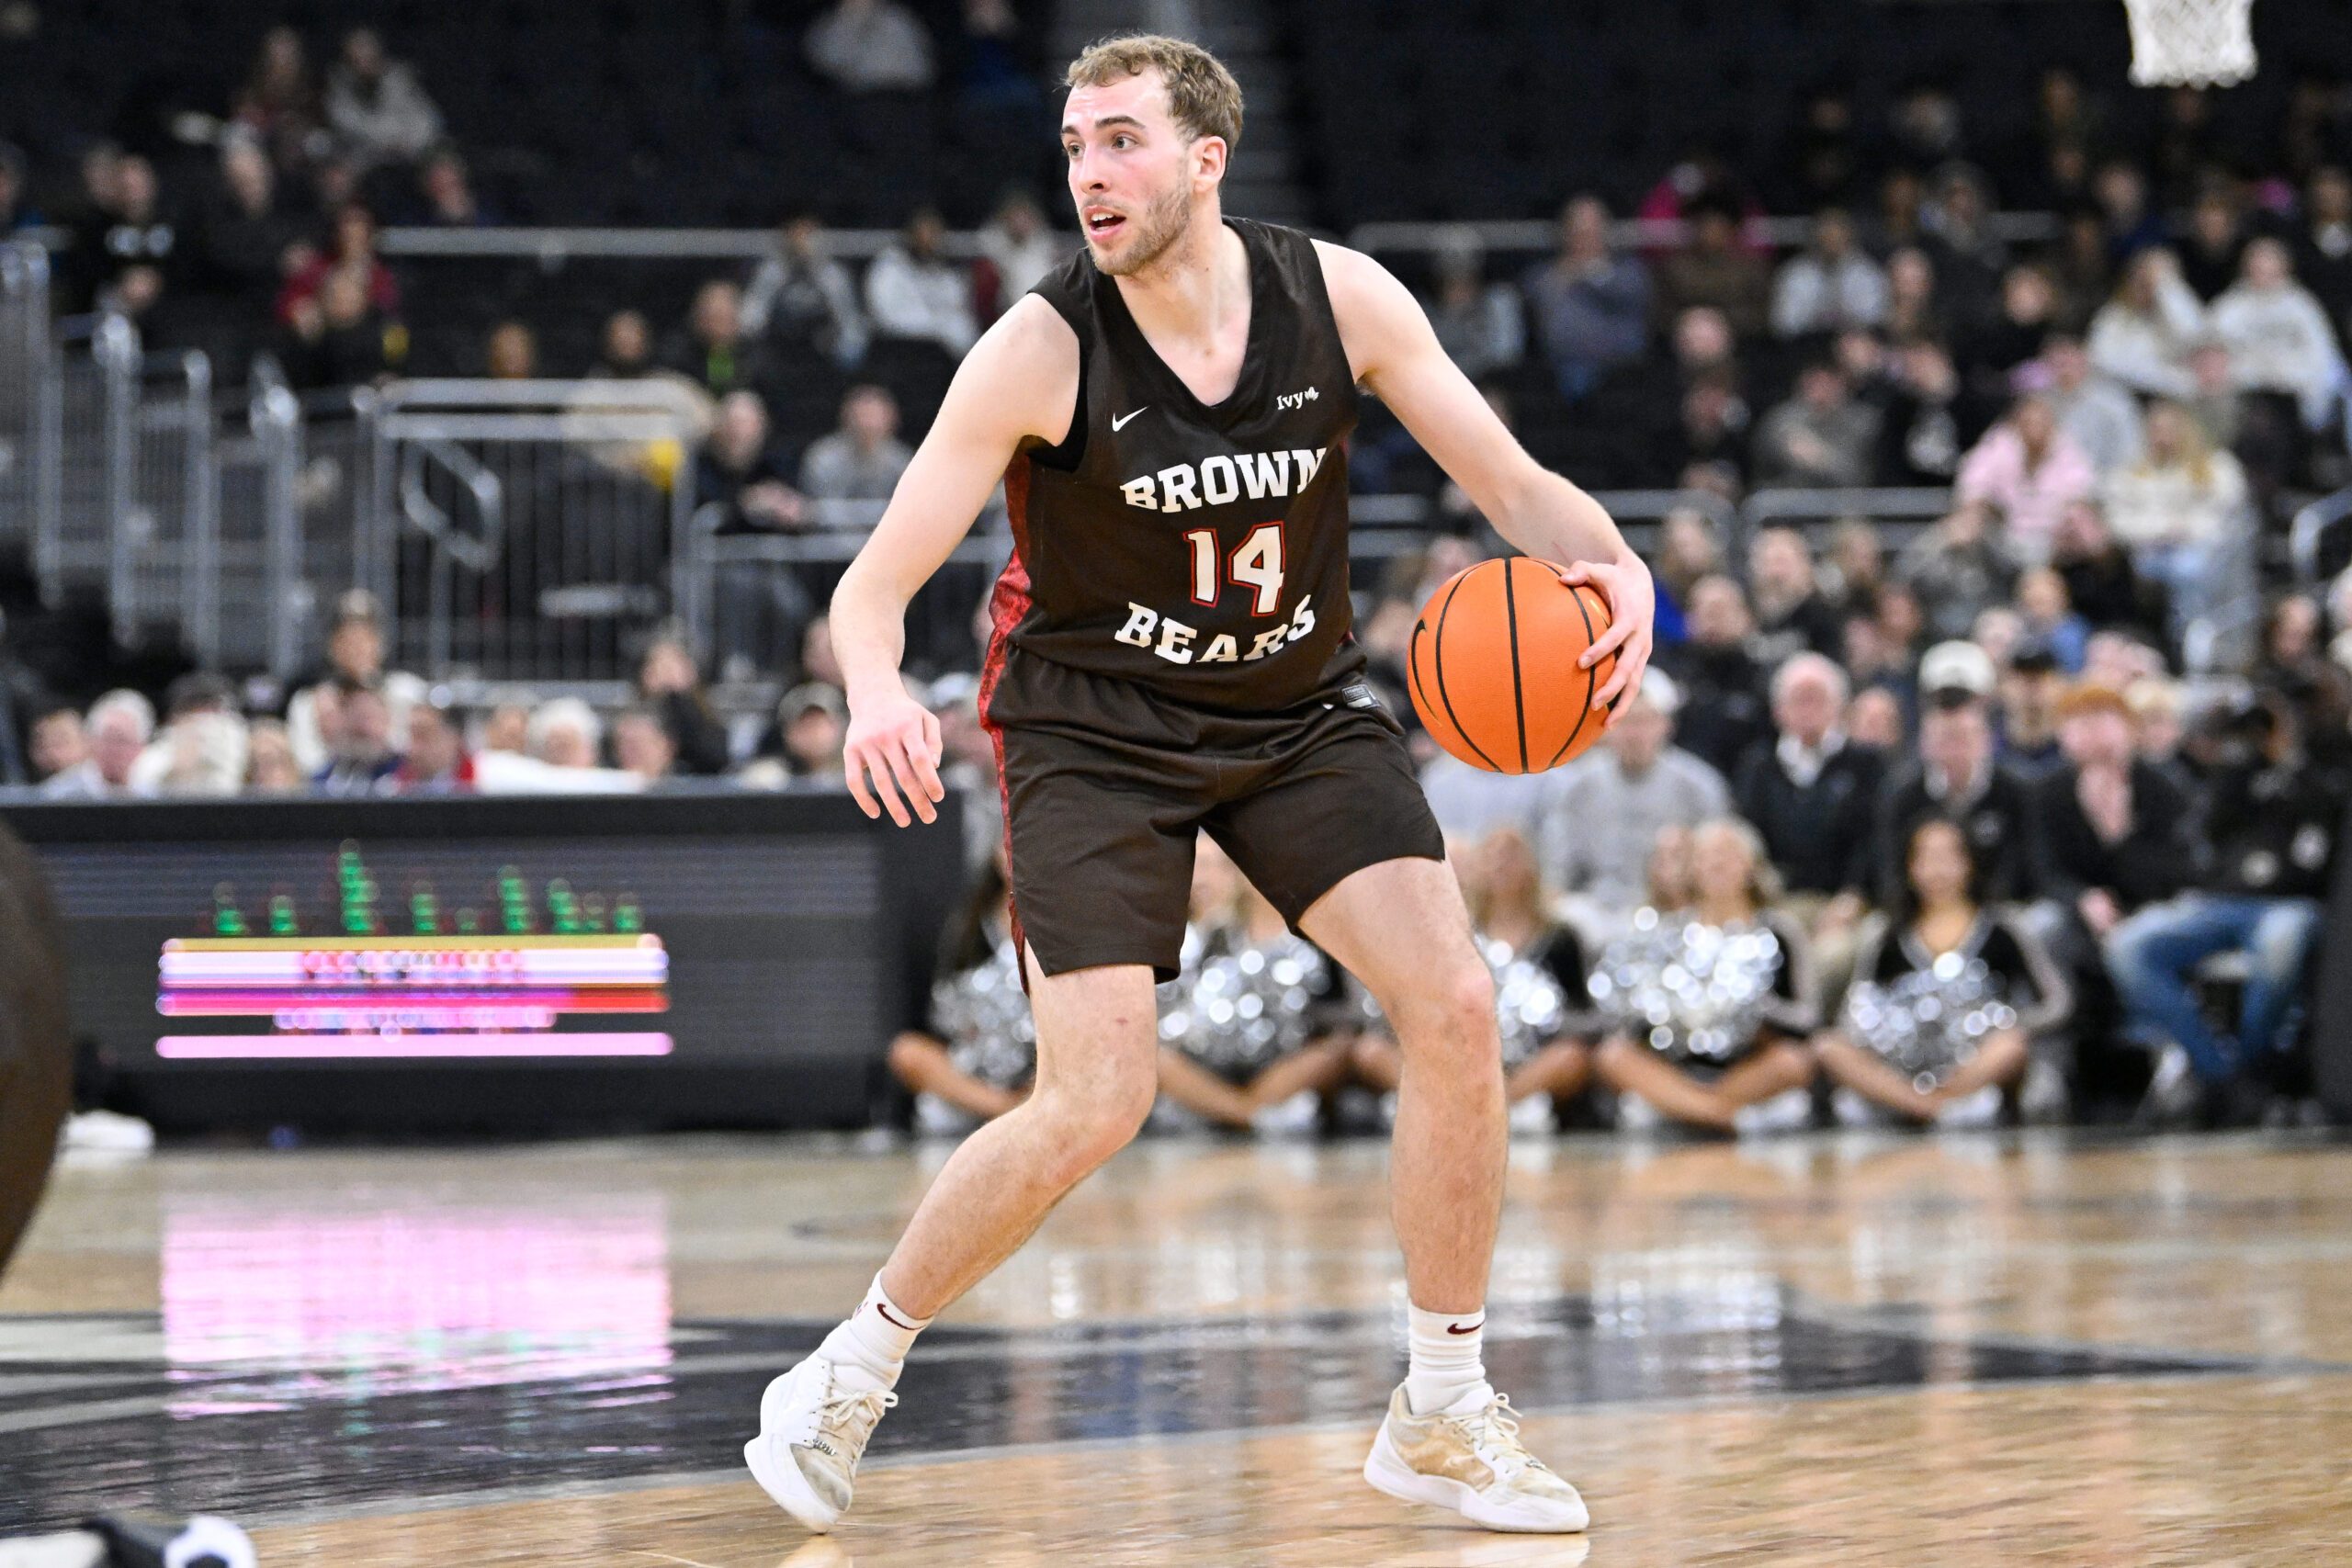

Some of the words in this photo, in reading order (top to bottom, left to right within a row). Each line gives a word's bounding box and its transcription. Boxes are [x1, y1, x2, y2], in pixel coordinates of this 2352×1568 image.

[1276, 391, 1304, 411] Ivy
[1120, 447, 1327, 513] BROWN
[1183, 521, 1284, 617] 14
[1114, 593, 1316, 665] BEARS
